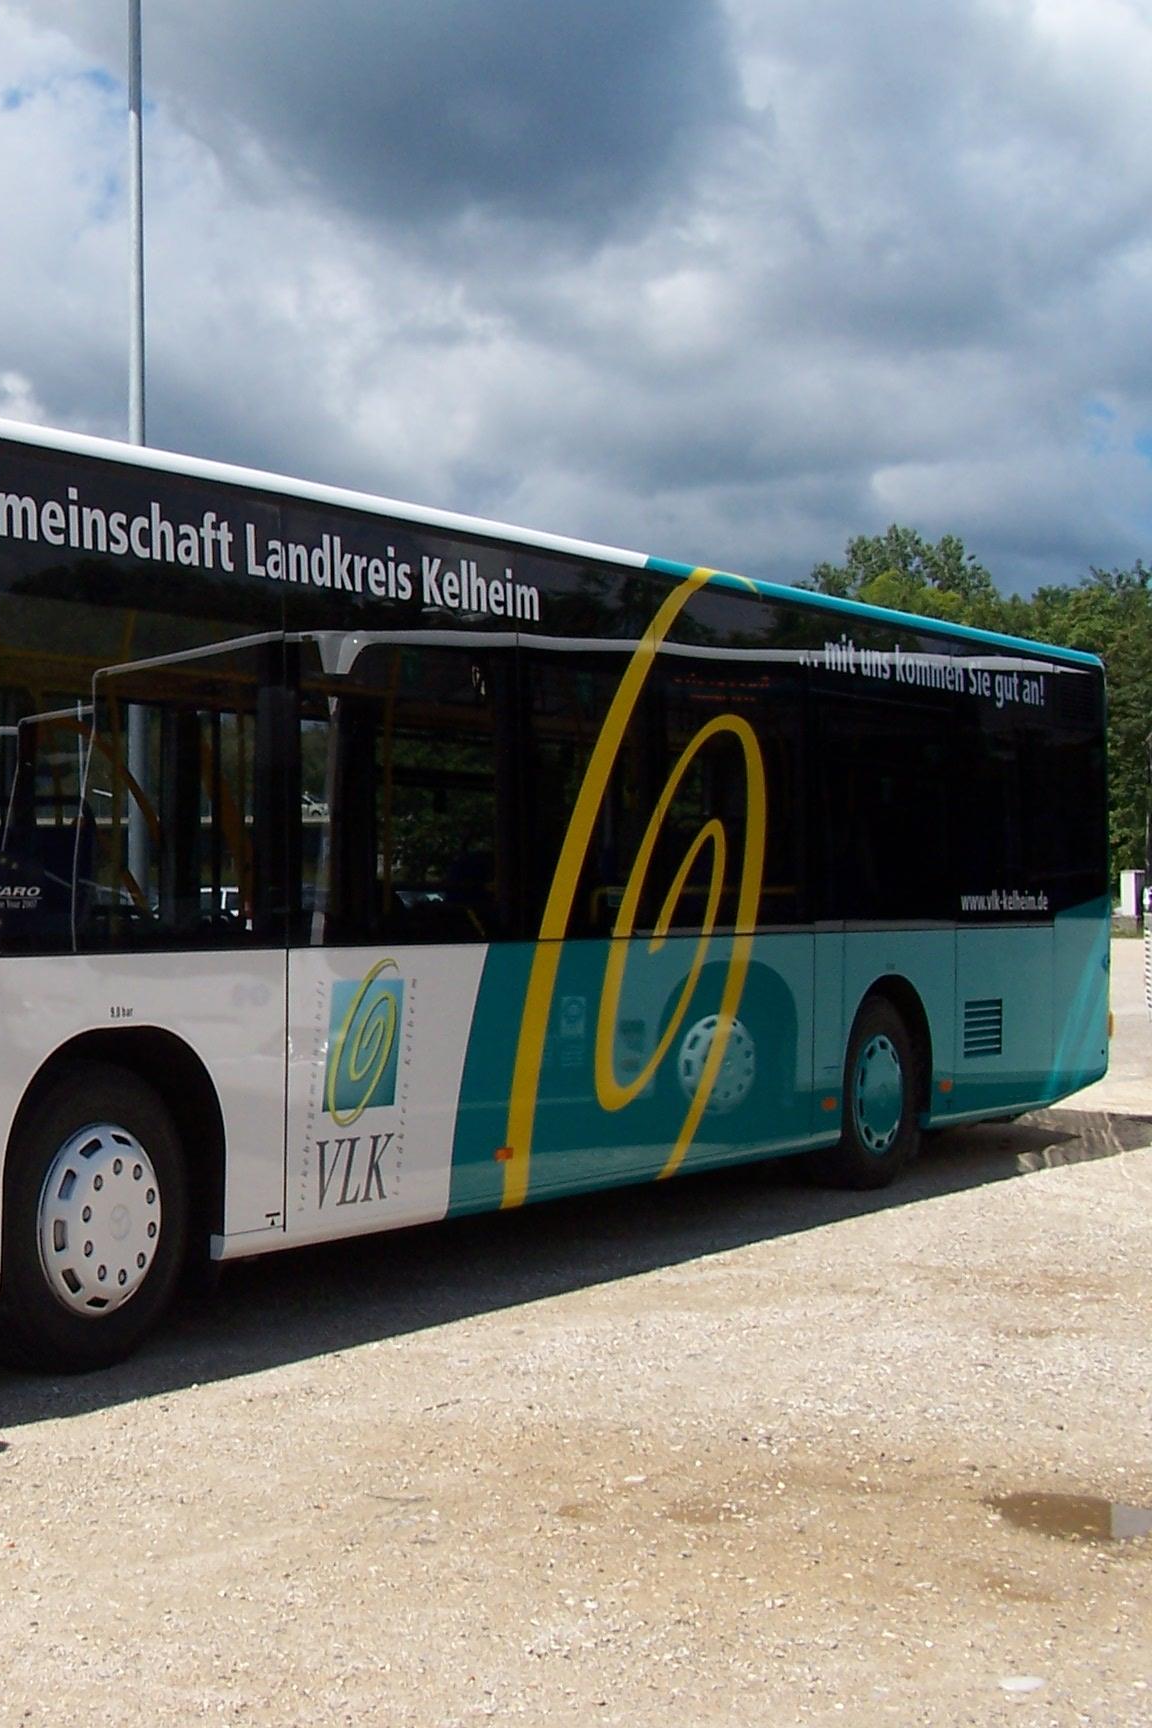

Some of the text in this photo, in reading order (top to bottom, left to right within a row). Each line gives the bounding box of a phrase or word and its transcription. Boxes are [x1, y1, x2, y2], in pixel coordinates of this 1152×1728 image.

[246, 523, 412, 601] Landkreis
[421, 556, 540, 621] Kelheim
[824, 634, 856, 674] mit
[860, 648, 890, 680] uns
[895, 644, 965, 692] kommen
[968, 661, 991, 697] Sie
[995, 672, 1019, 708] gut
[1022, 675, 1045, 706] an!
[960, 889, 1048, 911] www.vlk-kelheim.de
[316, 1132, 395, 1210] VLK
